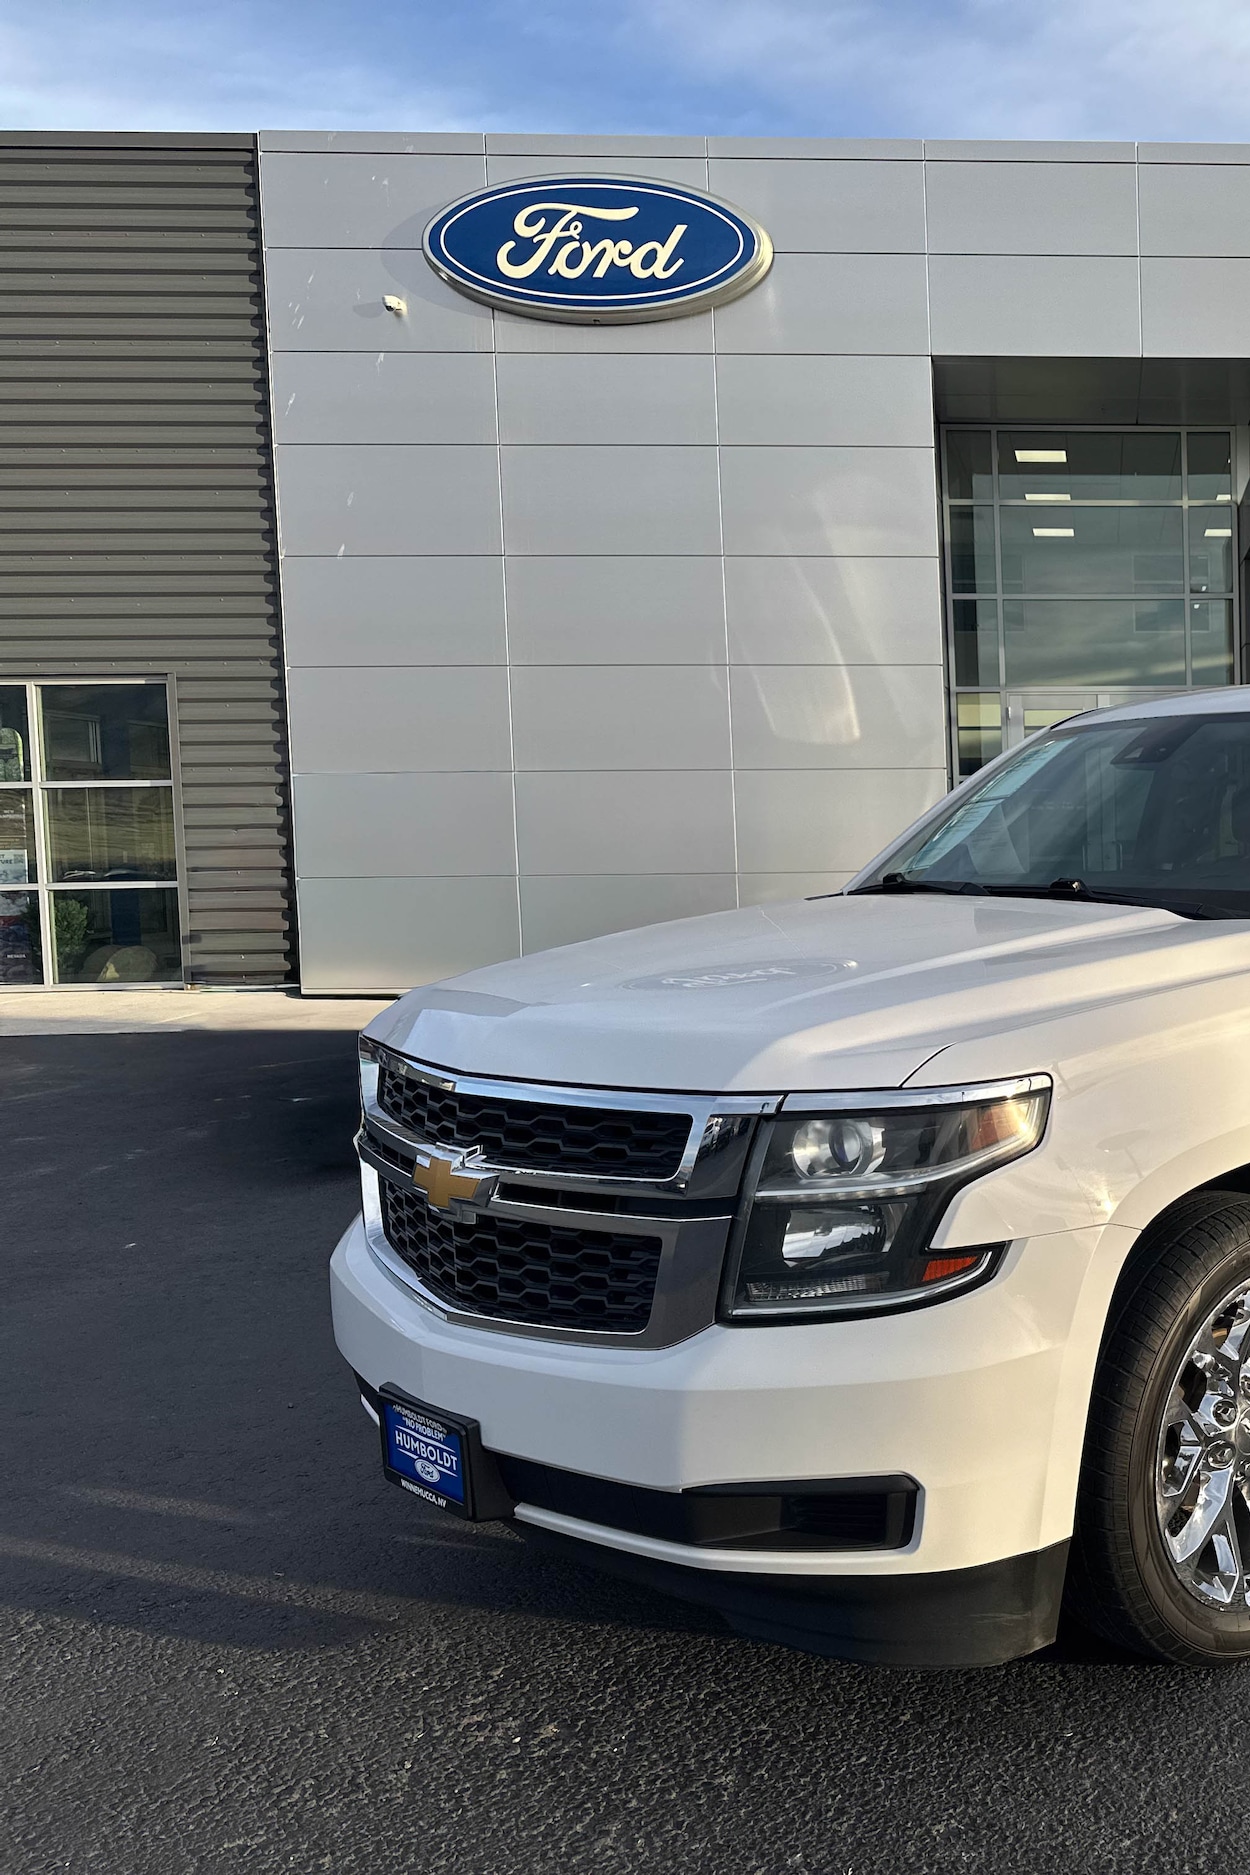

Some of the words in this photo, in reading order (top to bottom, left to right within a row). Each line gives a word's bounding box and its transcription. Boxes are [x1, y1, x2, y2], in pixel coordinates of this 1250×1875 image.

[496, 203, 687, 279] Ford
[395, 1430, 457, 1471] HUMBOLDT
[420, 1463, 434, 1478] Ford
[438, 1497, 446, 1508] NV
